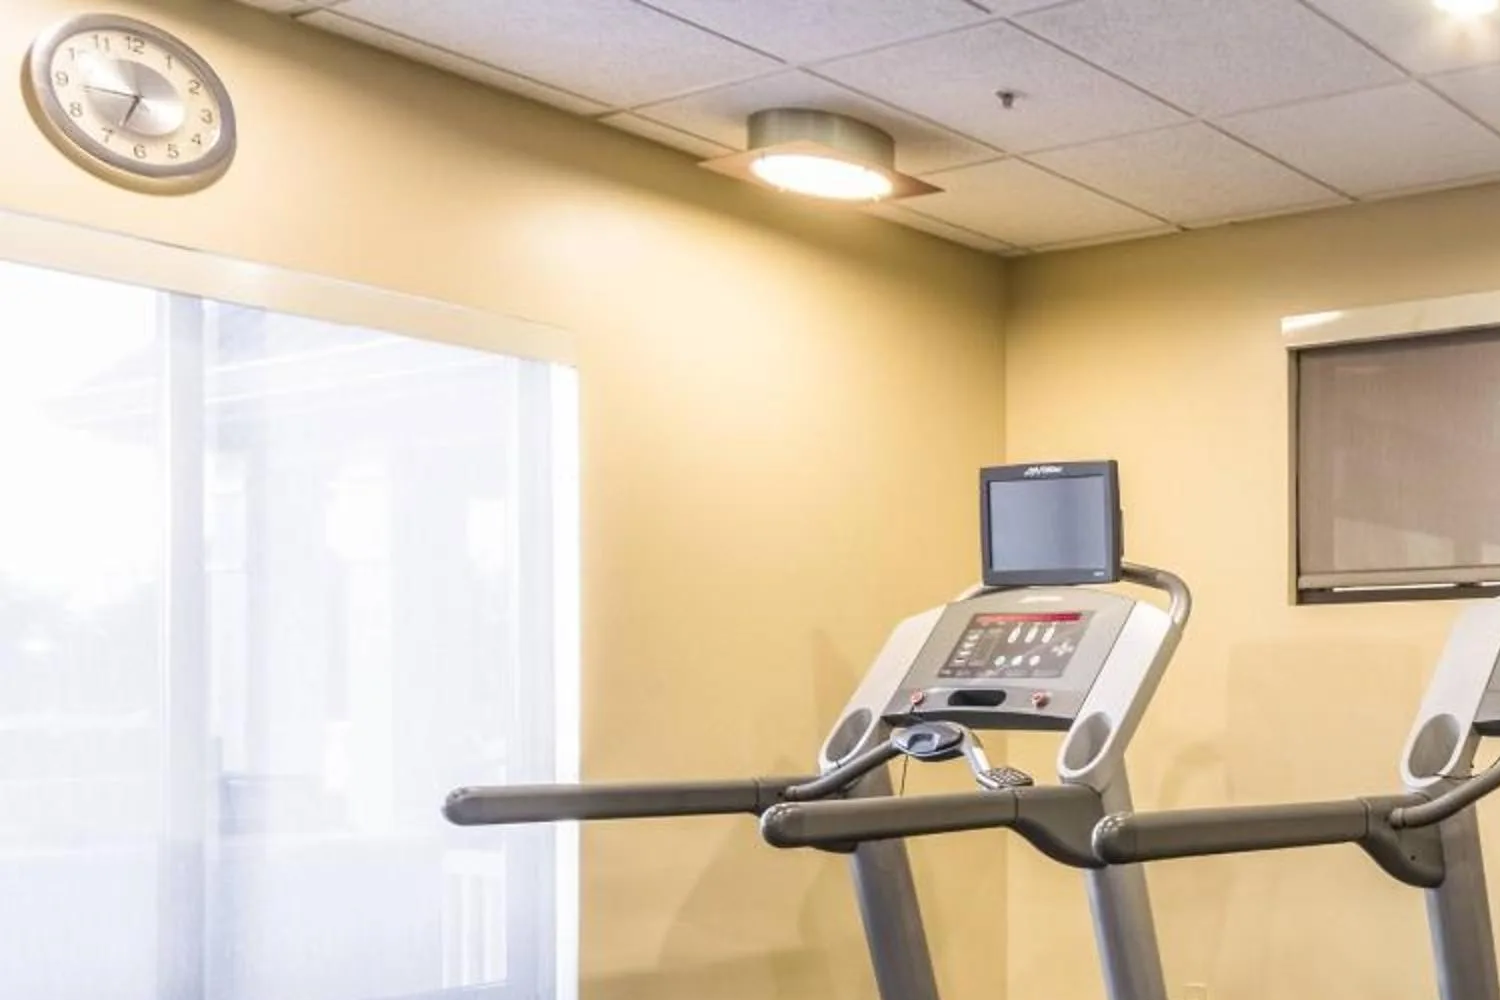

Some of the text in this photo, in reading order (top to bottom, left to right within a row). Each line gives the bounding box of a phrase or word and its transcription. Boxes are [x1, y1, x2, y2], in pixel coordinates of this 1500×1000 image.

[92, 34, 111, 53] 11
[125, 35, 146, 55] 12
[165, 54, 174, 71] 1
[55, 71, 69, 88] 9
[188, 78, 201, 96] 2
[69, 102, 83, 118] 8
[200, 107, 214, 125] 3
[101, 126, 115, 143] 7
[191, 133, 202, 146] 4
[133, 143, 147, 160] 6
[166, 143, 180, 160] 5
